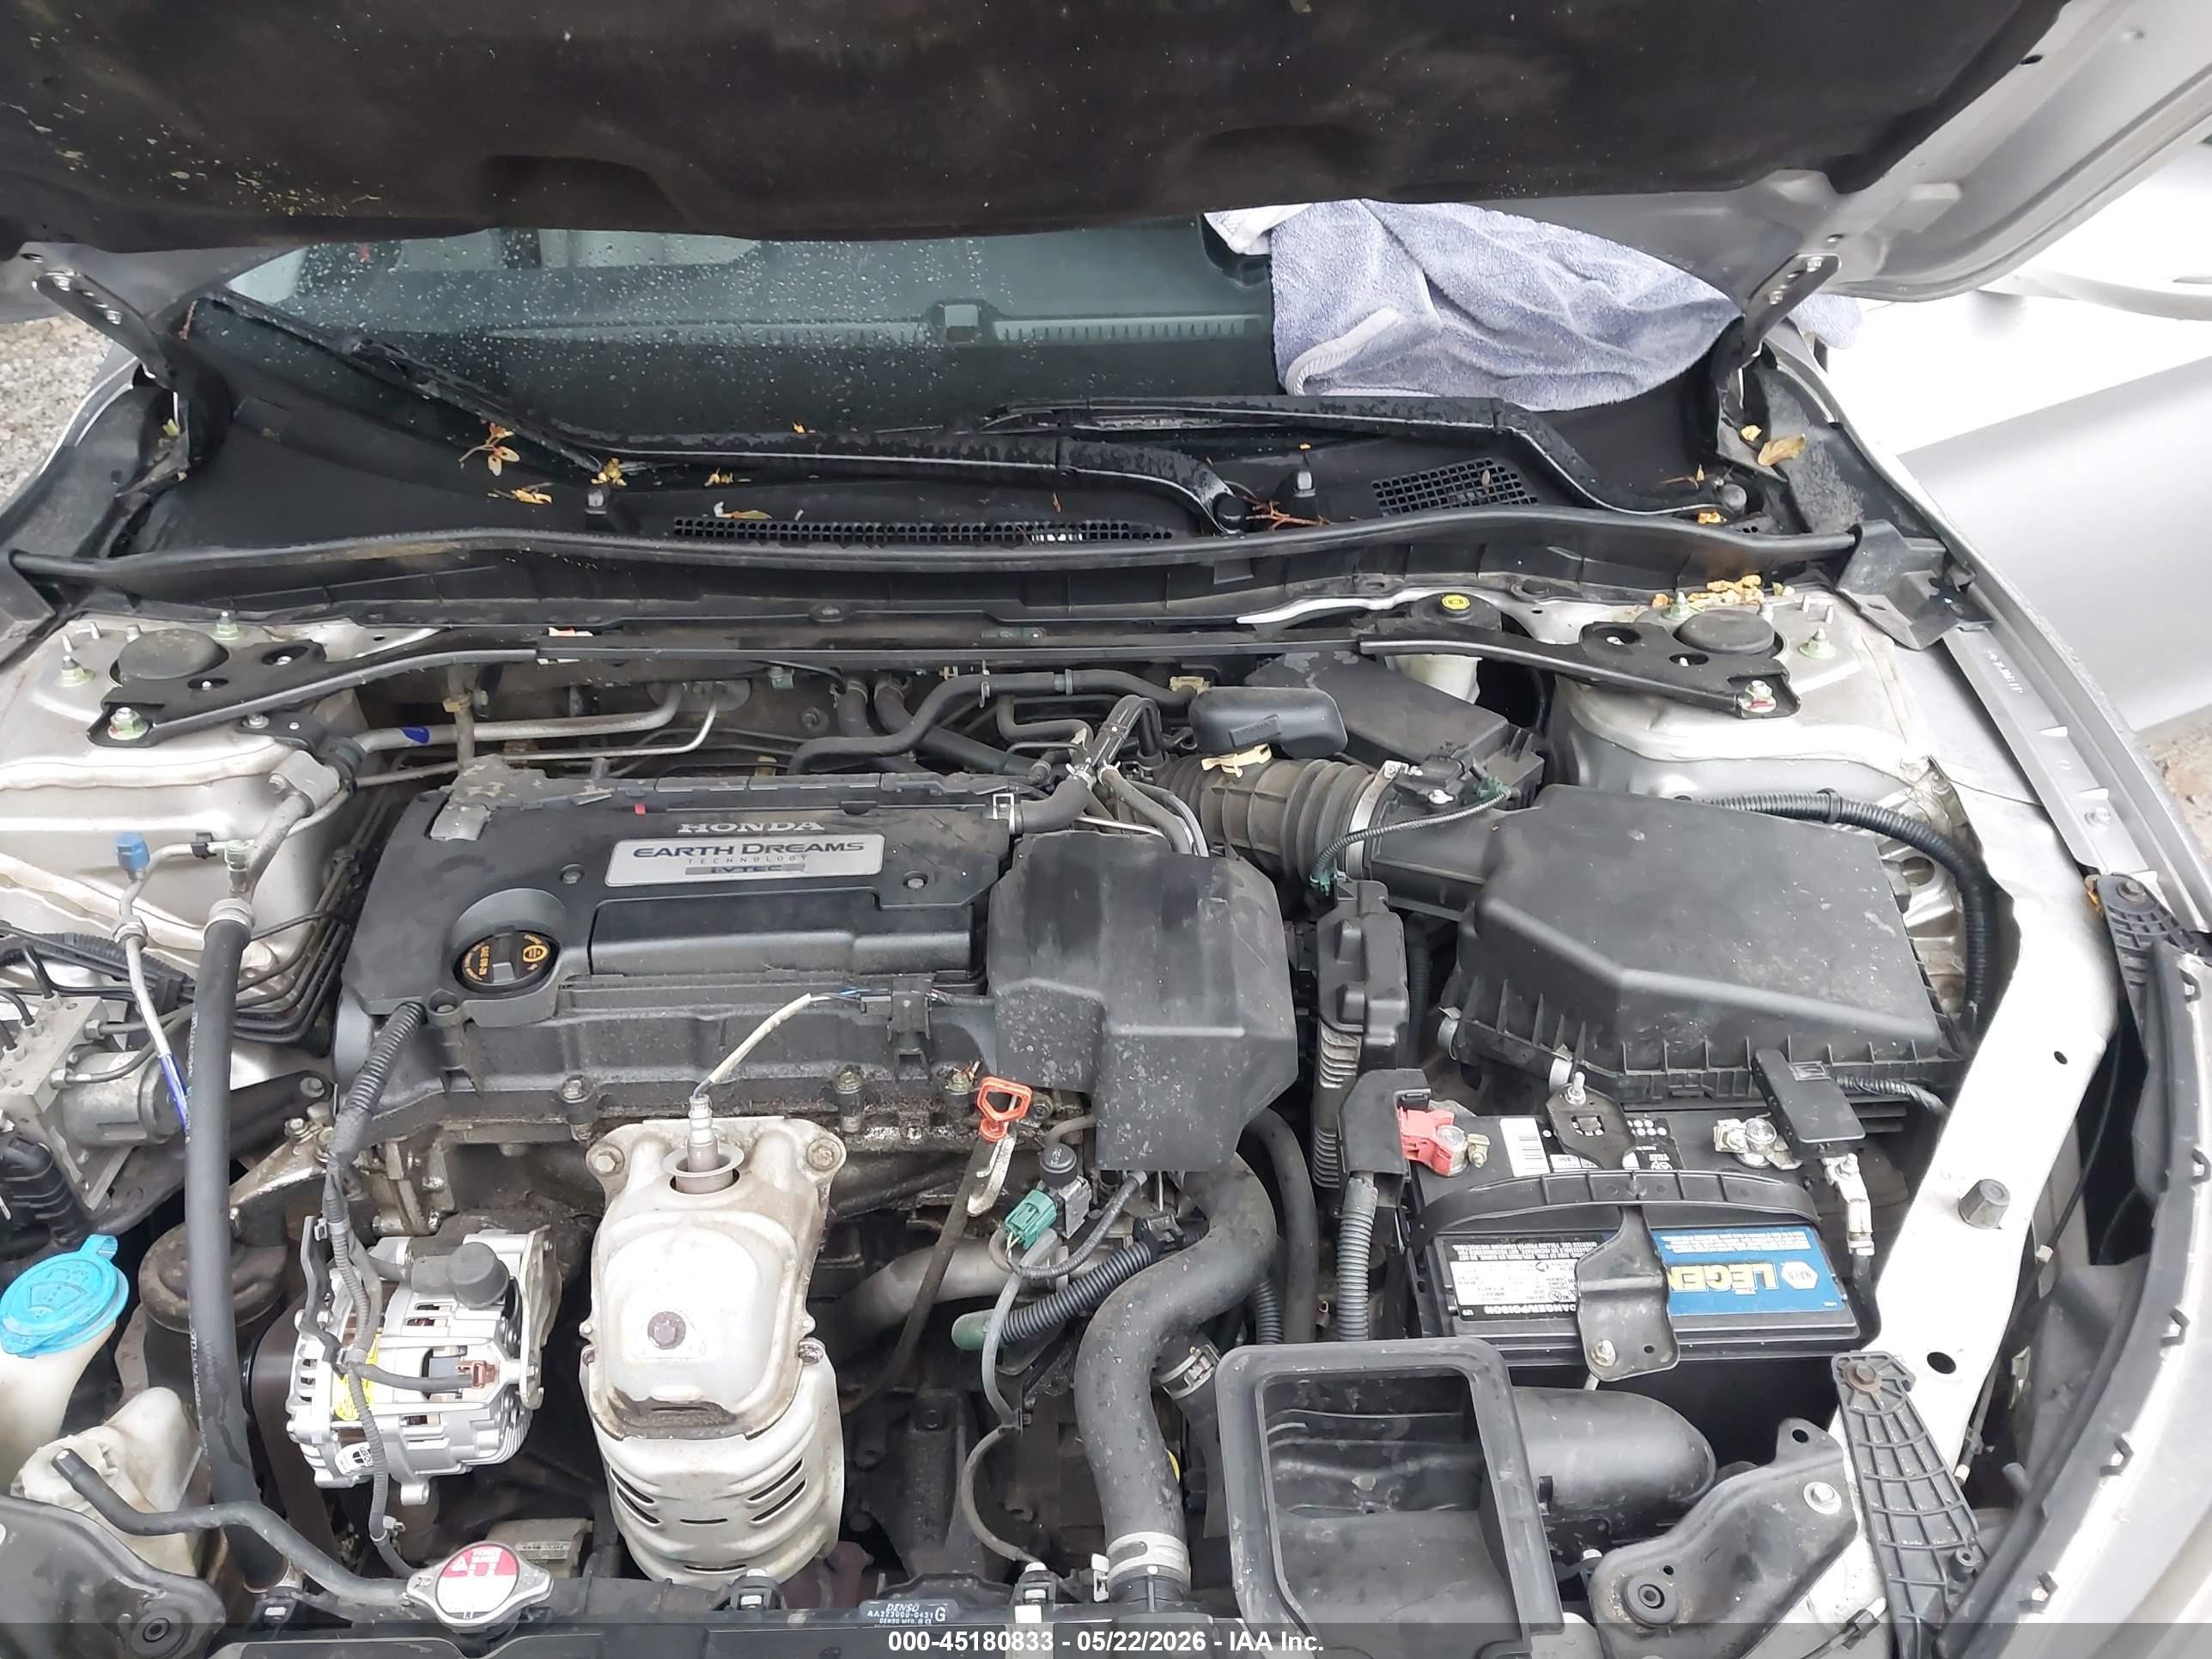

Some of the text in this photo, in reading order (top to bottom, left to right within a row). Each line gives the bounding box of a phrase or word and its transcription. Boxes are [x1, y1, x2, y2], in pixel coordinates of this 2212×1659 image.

[678, 821, 824, 834] HONDA
[633, 842, 866, 858] EARTH DREAMS
[689, 854, 809, 865] TECHNOLOGY
[1666, 1262, 1779, 1292] LEGEN
[1484, 1304, 1577, 1315] DANGER/POISON
[886, 1602, 921, 1613] DENSO
[934, 1606, 946, 1622] G
